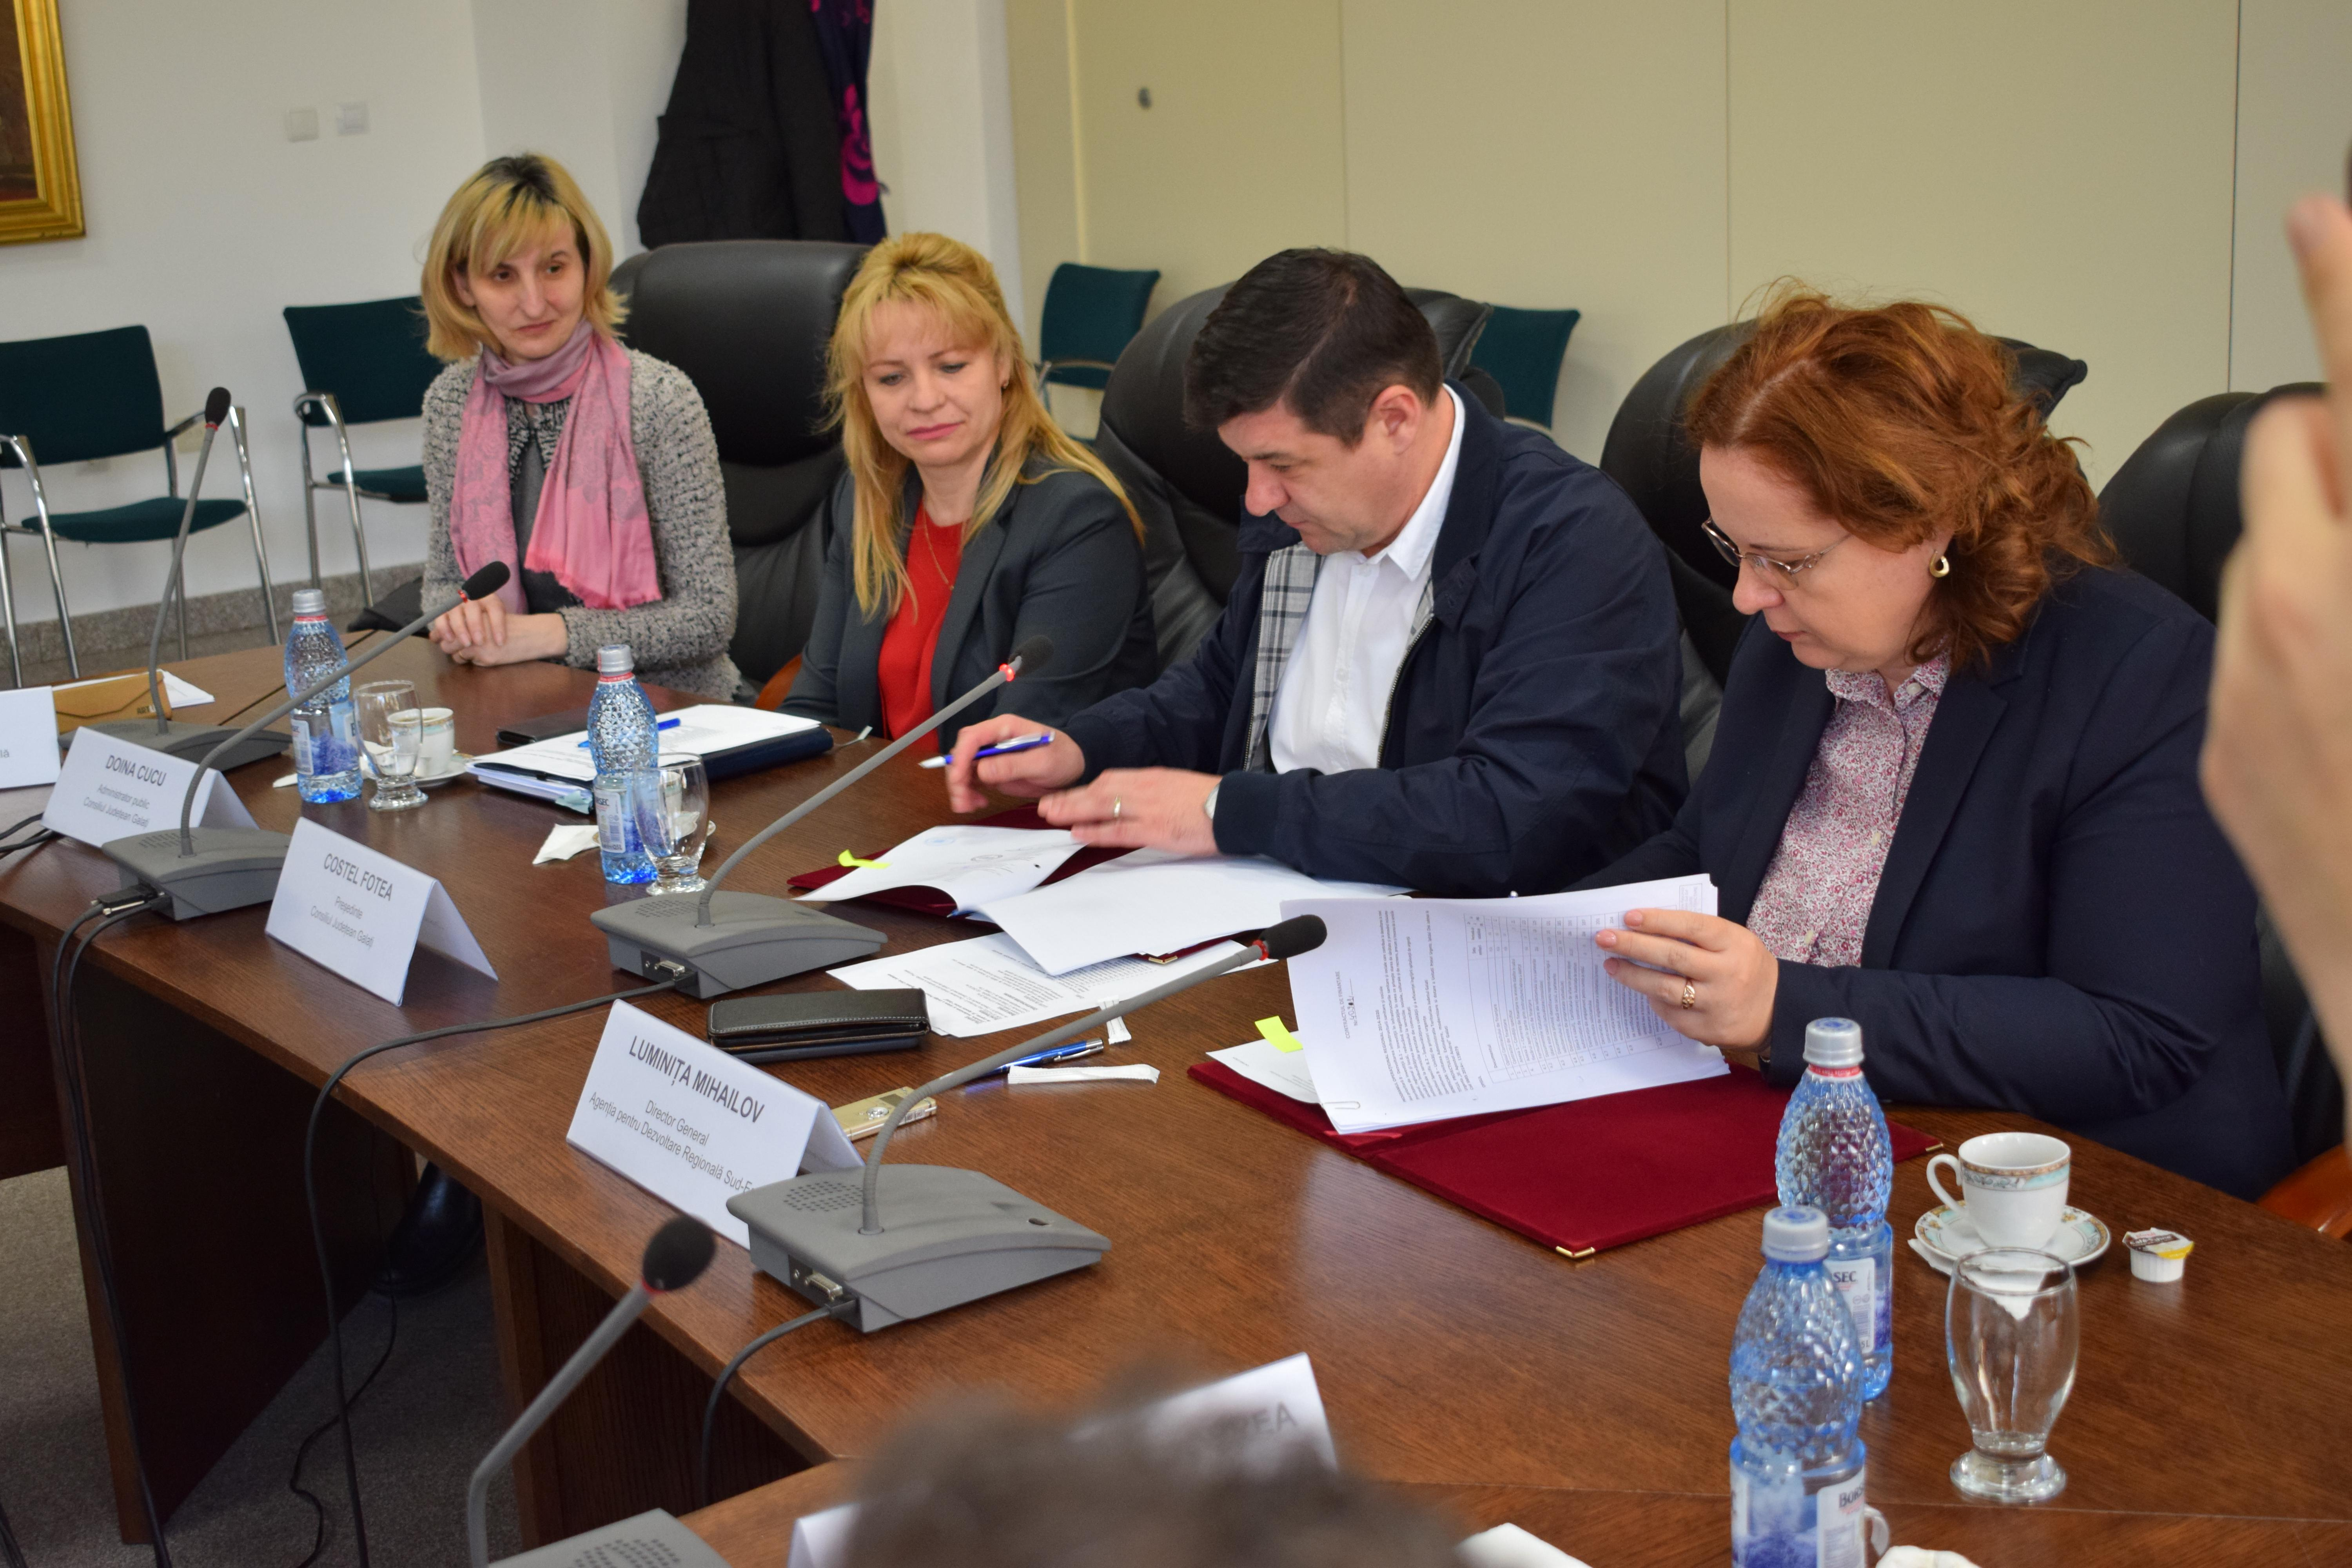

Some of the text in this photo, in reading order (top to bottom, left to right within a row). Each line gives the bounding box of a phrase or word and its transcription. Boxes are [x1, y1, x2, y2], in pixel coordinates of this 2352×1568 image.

[105, 755, 167, 786] DOINA CUCU
[83, 797, 107, 812] Consiliul
[98, 784, 150, 809] Administrator public
[324, 853, 393, 901] COSTEL FOTEA
[310, 906, 333, 925] Consiliul
[1341, 1008, 1350, 1038] CONTRACTUL
[1385, 1022, 1393, 1049] infrastructurii
[1391, 1051, 1400, 1074] Dezvoltarea
[1488, 1044, 1497, 1068] Documentul
[629, 1035, 765, 1123] LUMINIȚA MIHAILOV
[645, 1100, 710, 1146] Director General
[589, 1092, 754, 1194] Agenția pentru Dezvoltare Regională Sud-E
[1831, 1270, 1858, 1283] SEC
